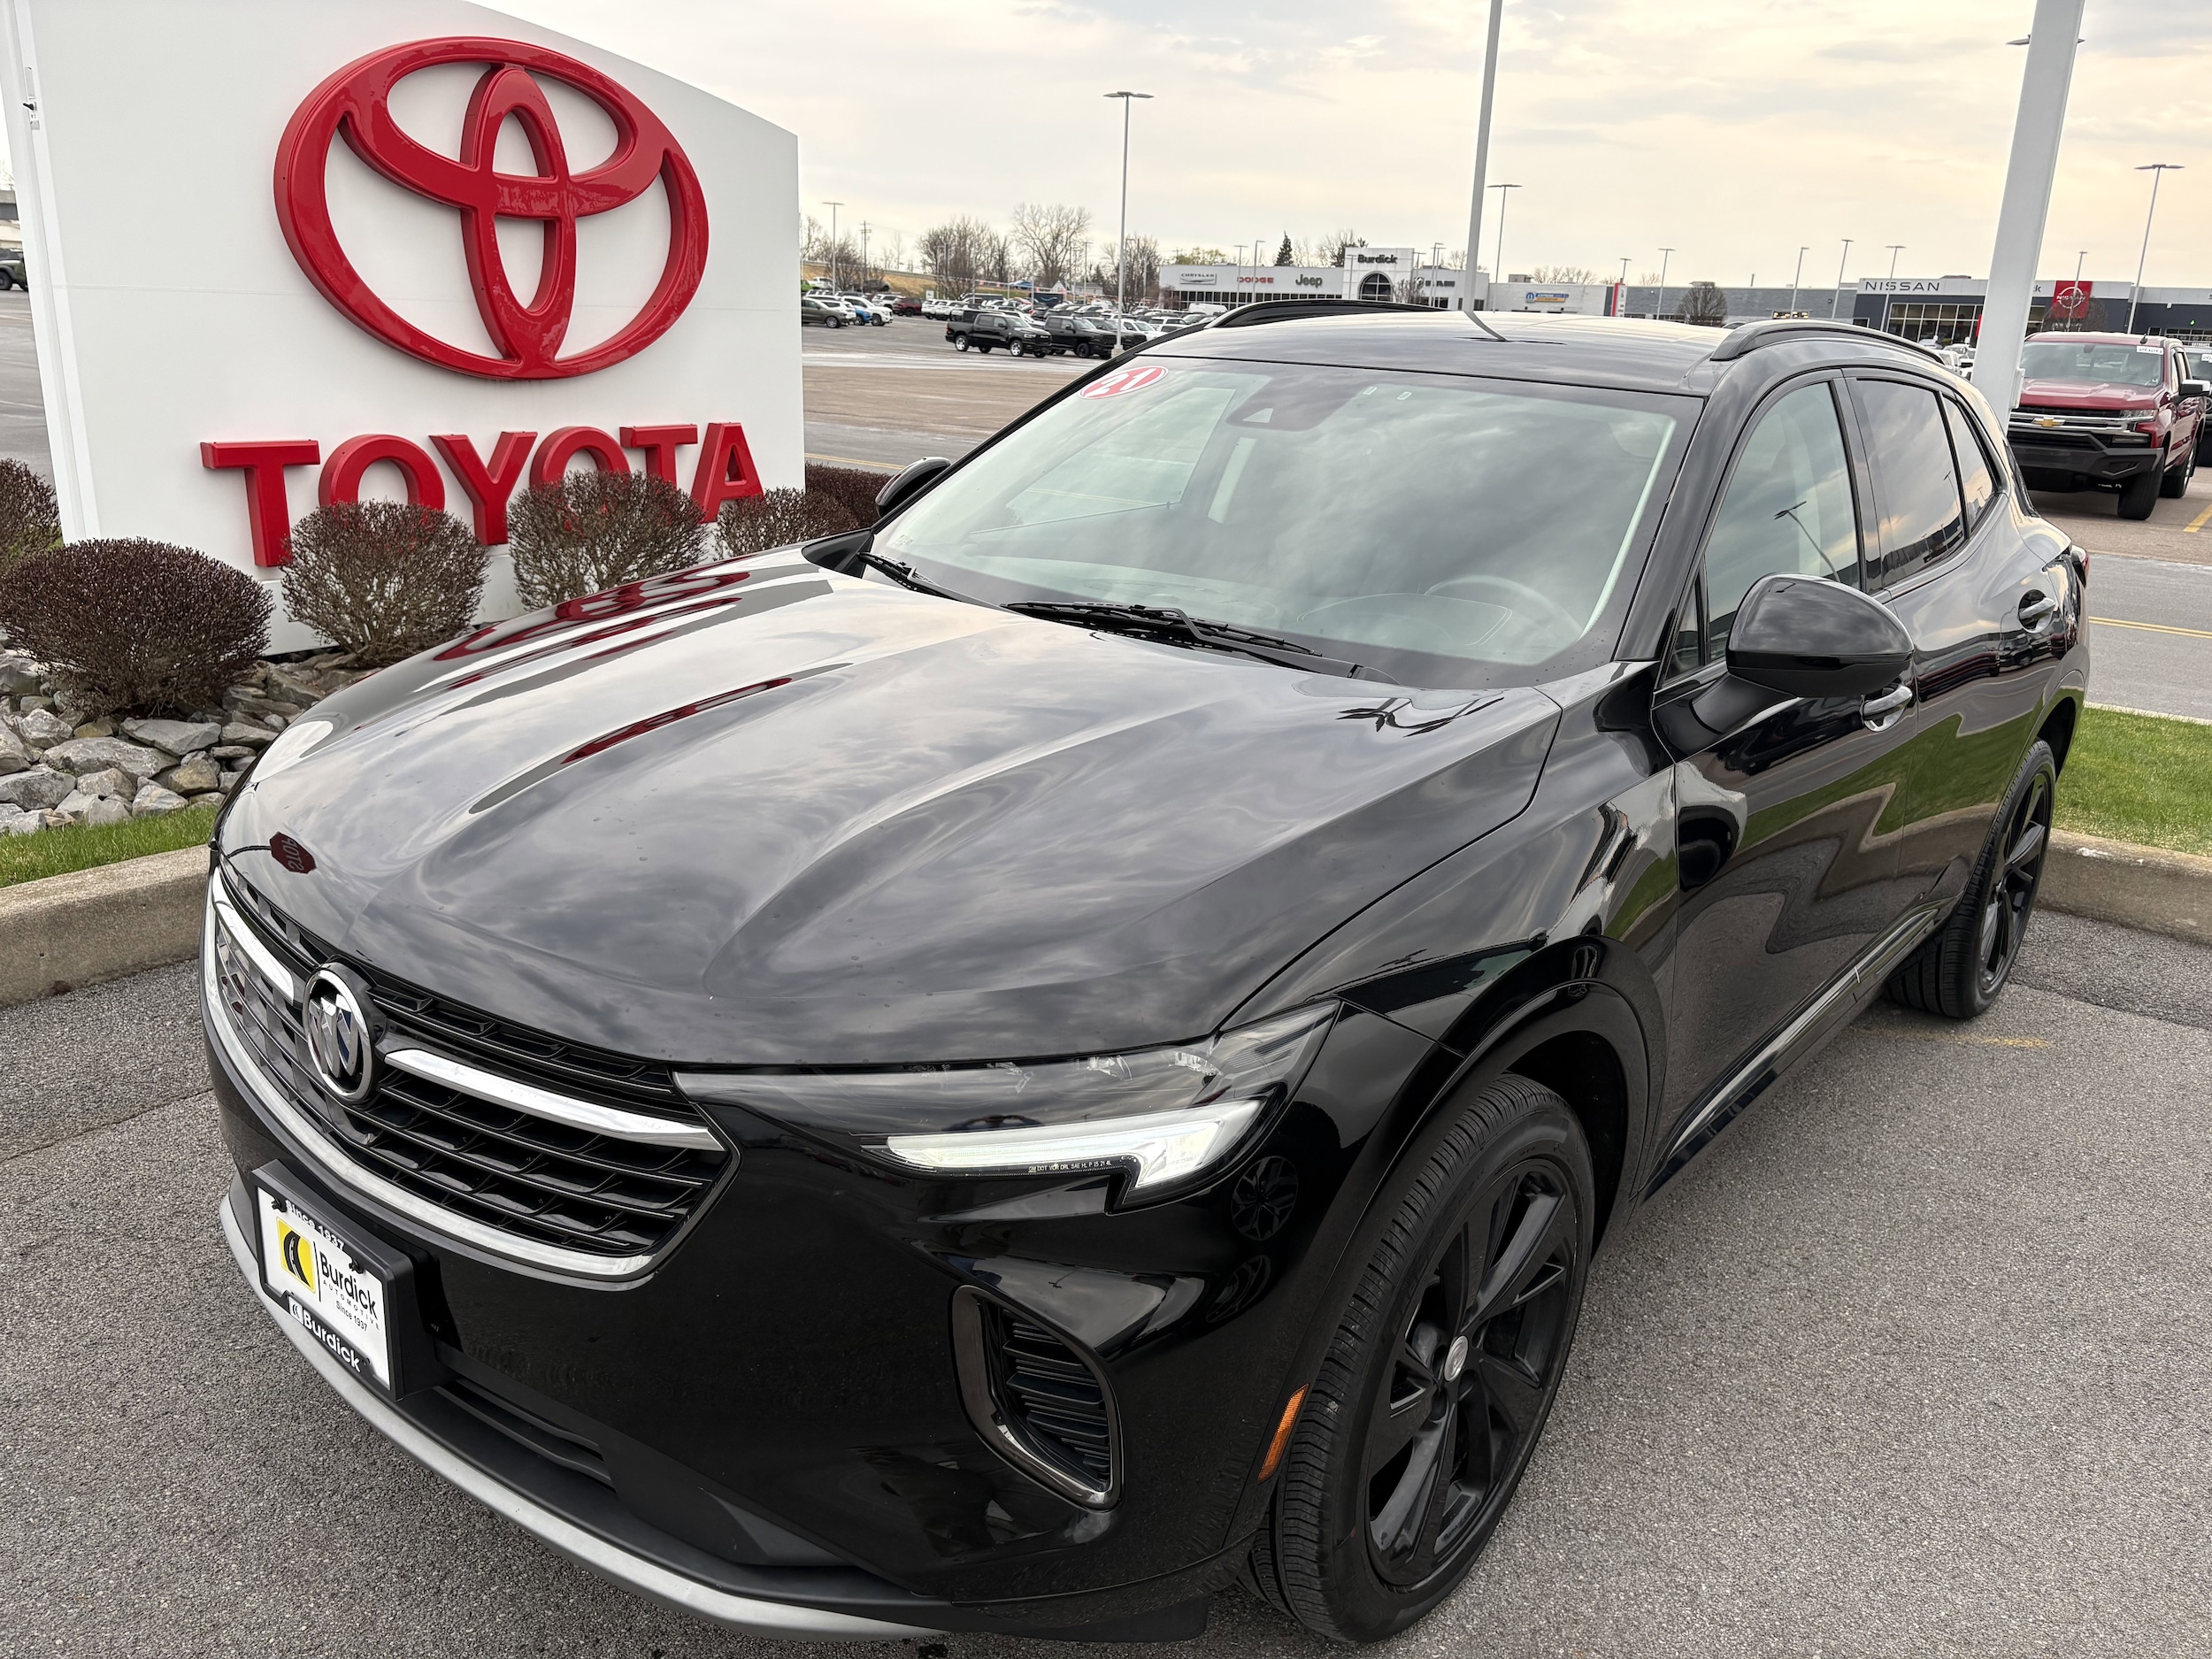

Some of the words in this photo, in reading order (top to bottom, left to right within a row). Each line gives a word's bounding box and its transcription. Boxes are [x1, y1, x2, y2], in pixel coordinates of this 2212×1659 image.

[1357, 254, 1398, 264] Burdick
[1294, 273, 1323, 288] Jeep
[1864, 281, 1939, 291] NISSAN
[1084, 367, 1157, 397] 21
[200, 422, 764, 567] TOYOTA
[285, 1199, 316, 1229] Since
[318, 1225, 344, 1250] 1937
[319, 1251, 379, 1320] Burdick
[323, 1279, 380, 1331] AUTOMOTIVE
[336, 1301, 352, 1320] Since
[354, 1315, 367, 1332] 1937
[303, 1309, 361, 1373] Burdick
